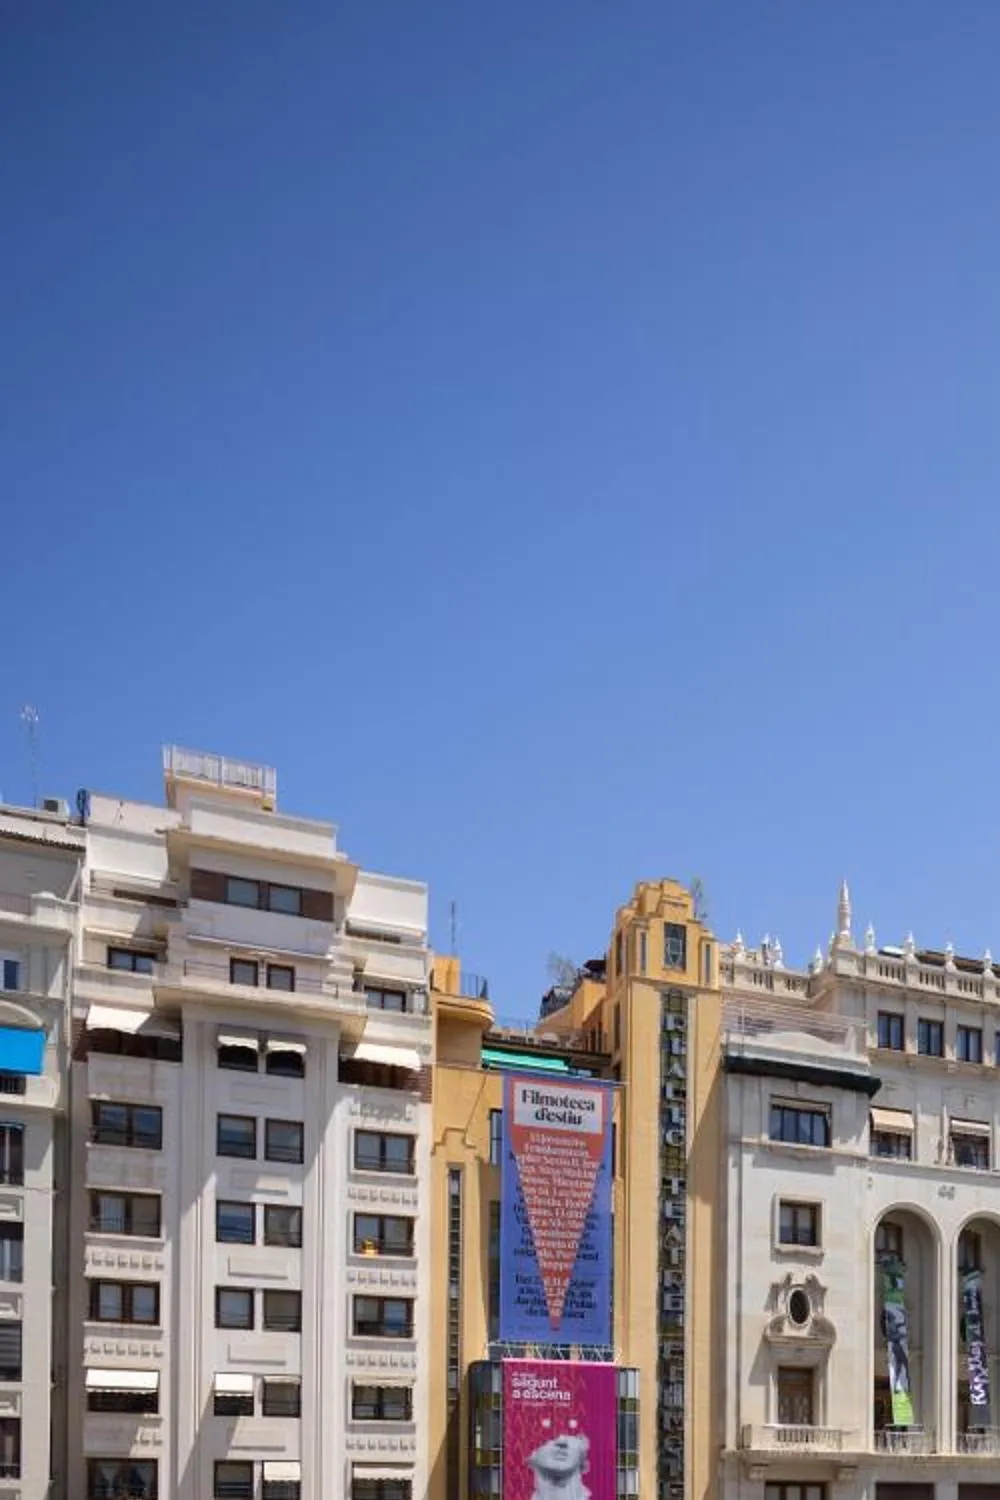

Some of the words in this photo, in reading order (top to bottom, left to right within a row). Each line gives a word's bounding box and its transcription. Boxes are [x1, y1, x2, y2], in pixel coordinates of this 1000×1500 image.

[522, 1089, 595, 1112] Filmoteca
[535, 1107, 582, 1125] d'estiu
[523, 1390, 571, 1401] escena
